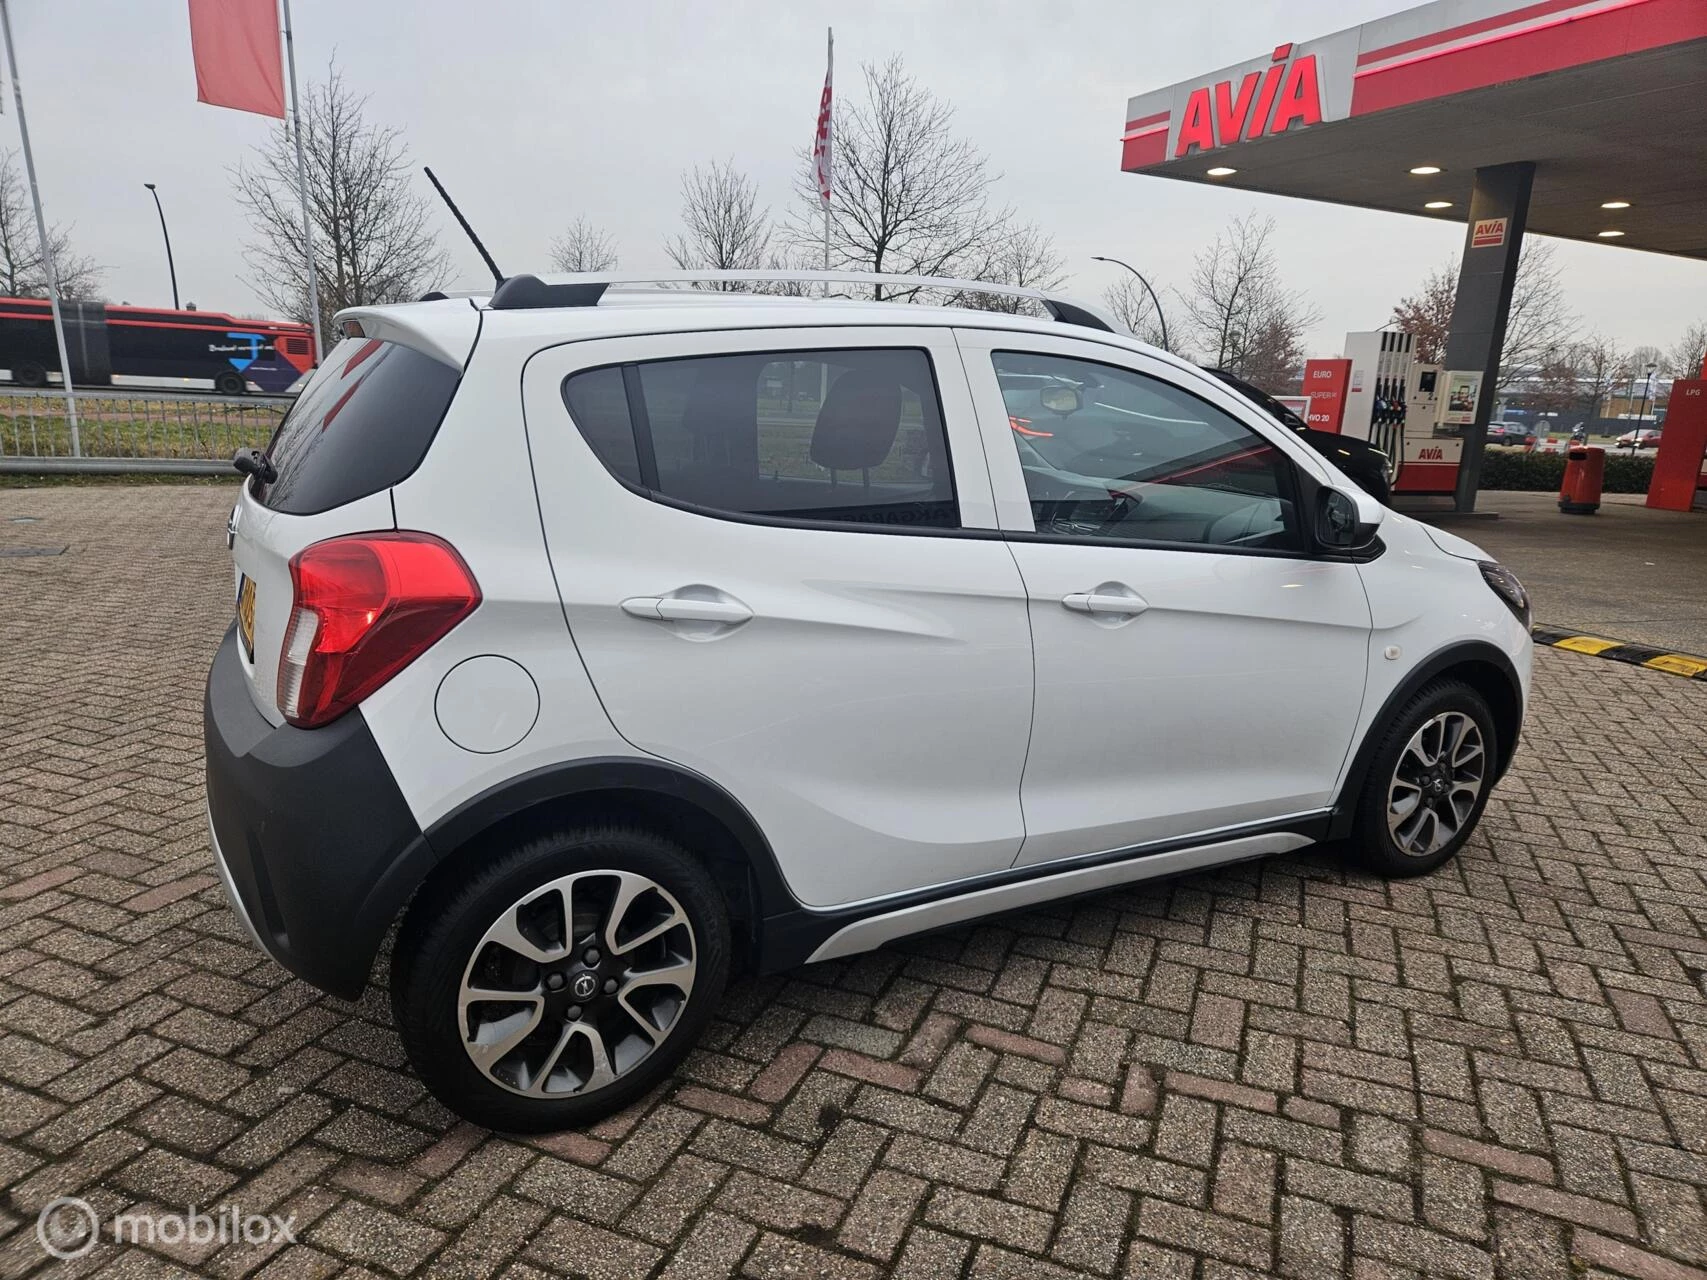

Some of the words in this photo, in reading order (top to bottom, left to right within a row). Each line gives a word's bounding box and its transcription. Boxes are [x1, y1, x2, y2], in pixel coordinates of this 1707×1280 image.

[1312, 370, 1332, 379] EURO
[1686, 388, 1701, 396] LPG
[1321, 413, 1330, 422] 20
